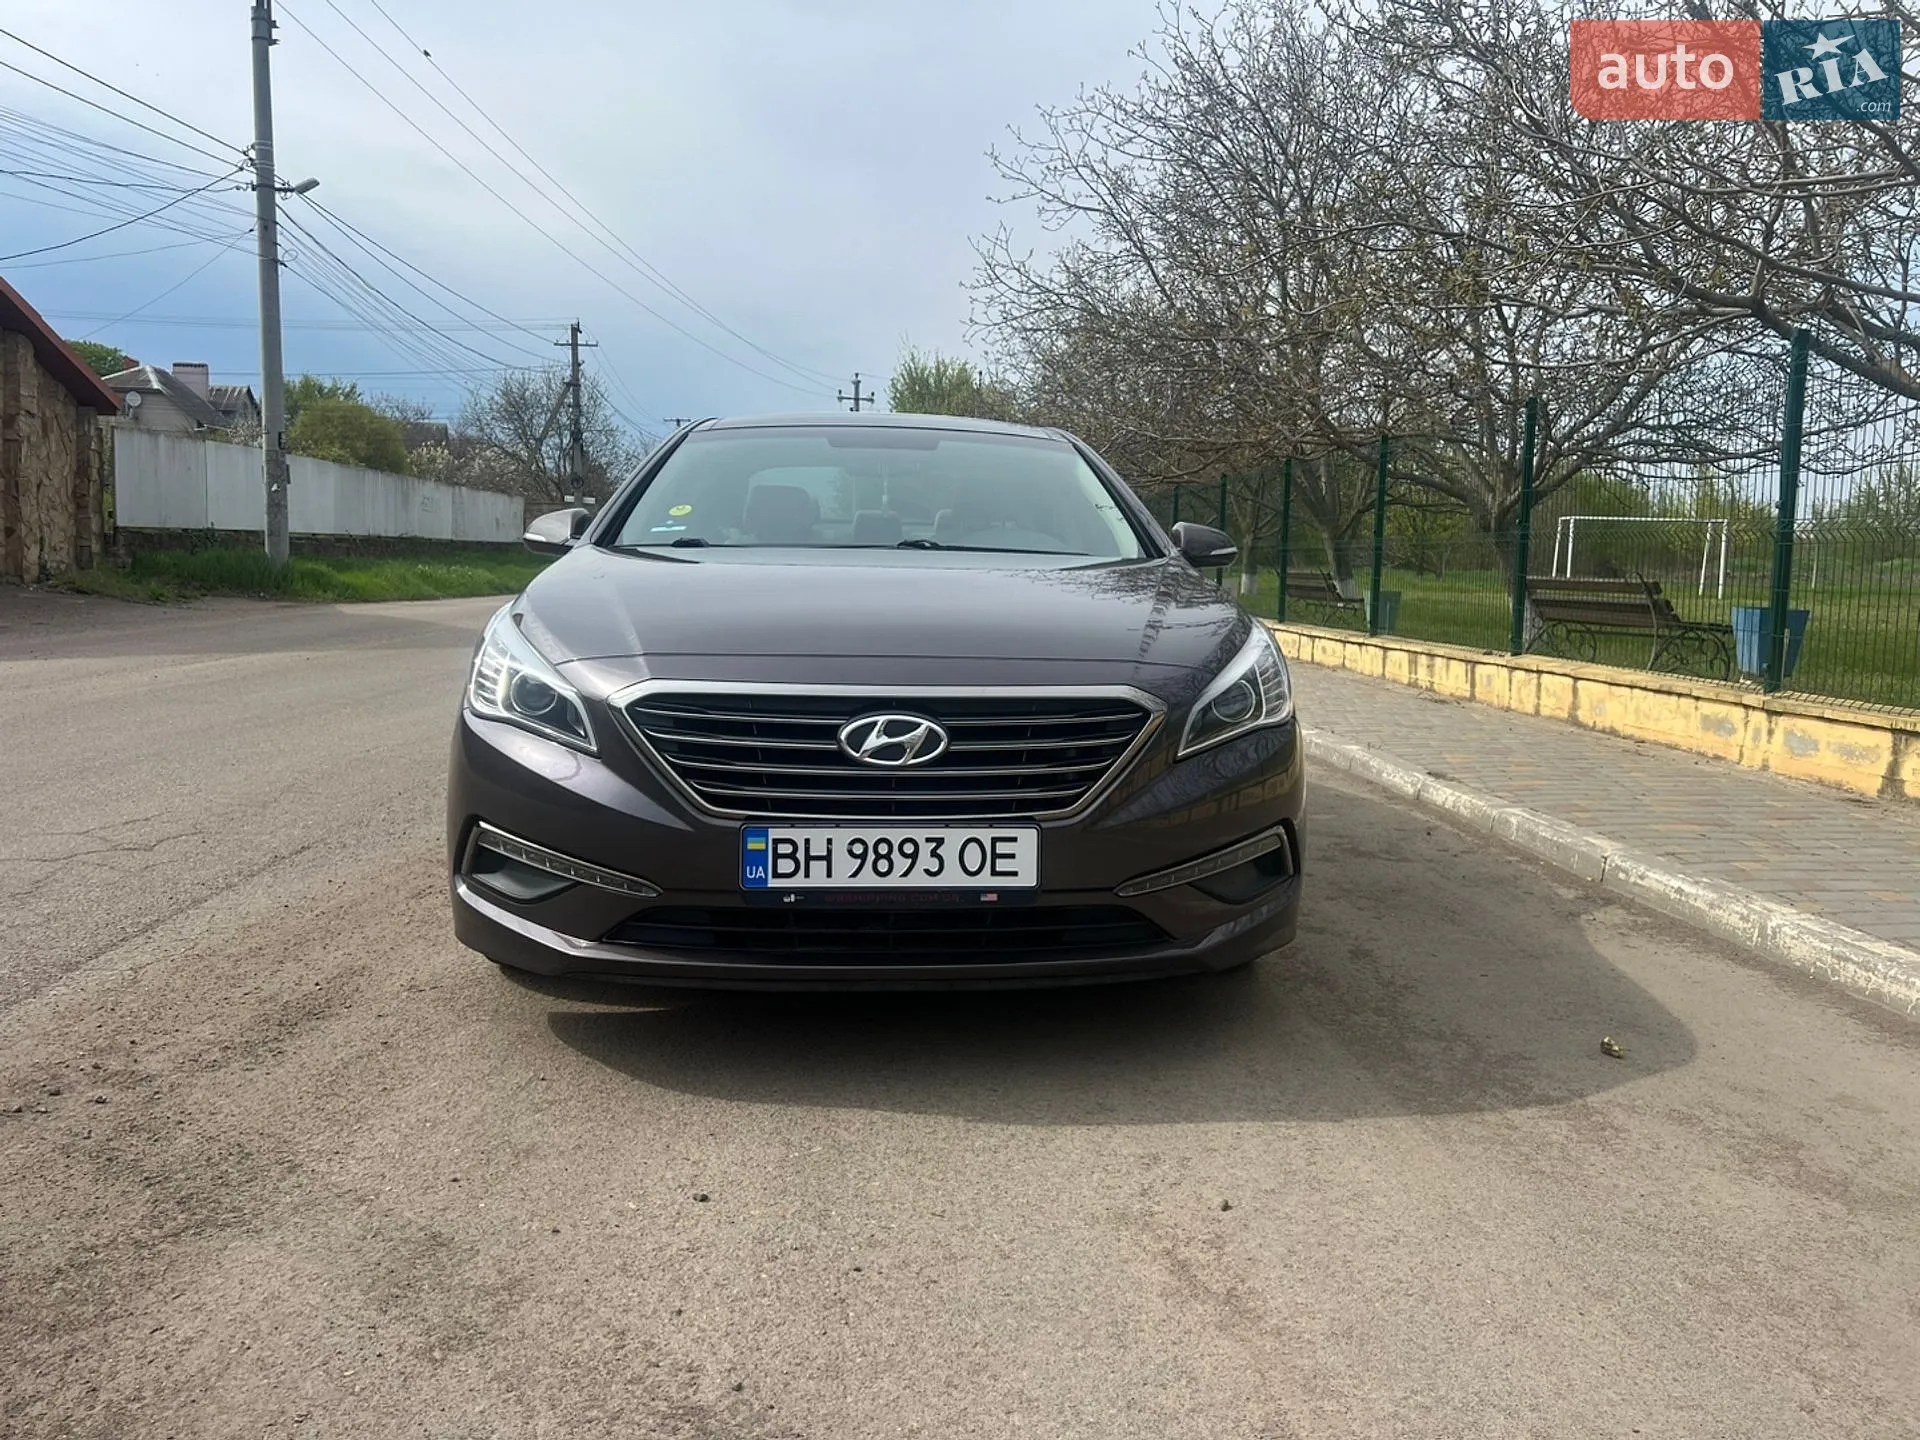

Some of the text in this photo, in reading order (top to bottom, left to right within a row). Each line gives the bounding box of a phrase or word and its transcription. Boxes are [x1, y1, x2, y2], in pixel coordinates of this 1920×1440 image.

[771, 836, 1019, 879] BH 9893 OE
[746, 866, 765, 879] UA
